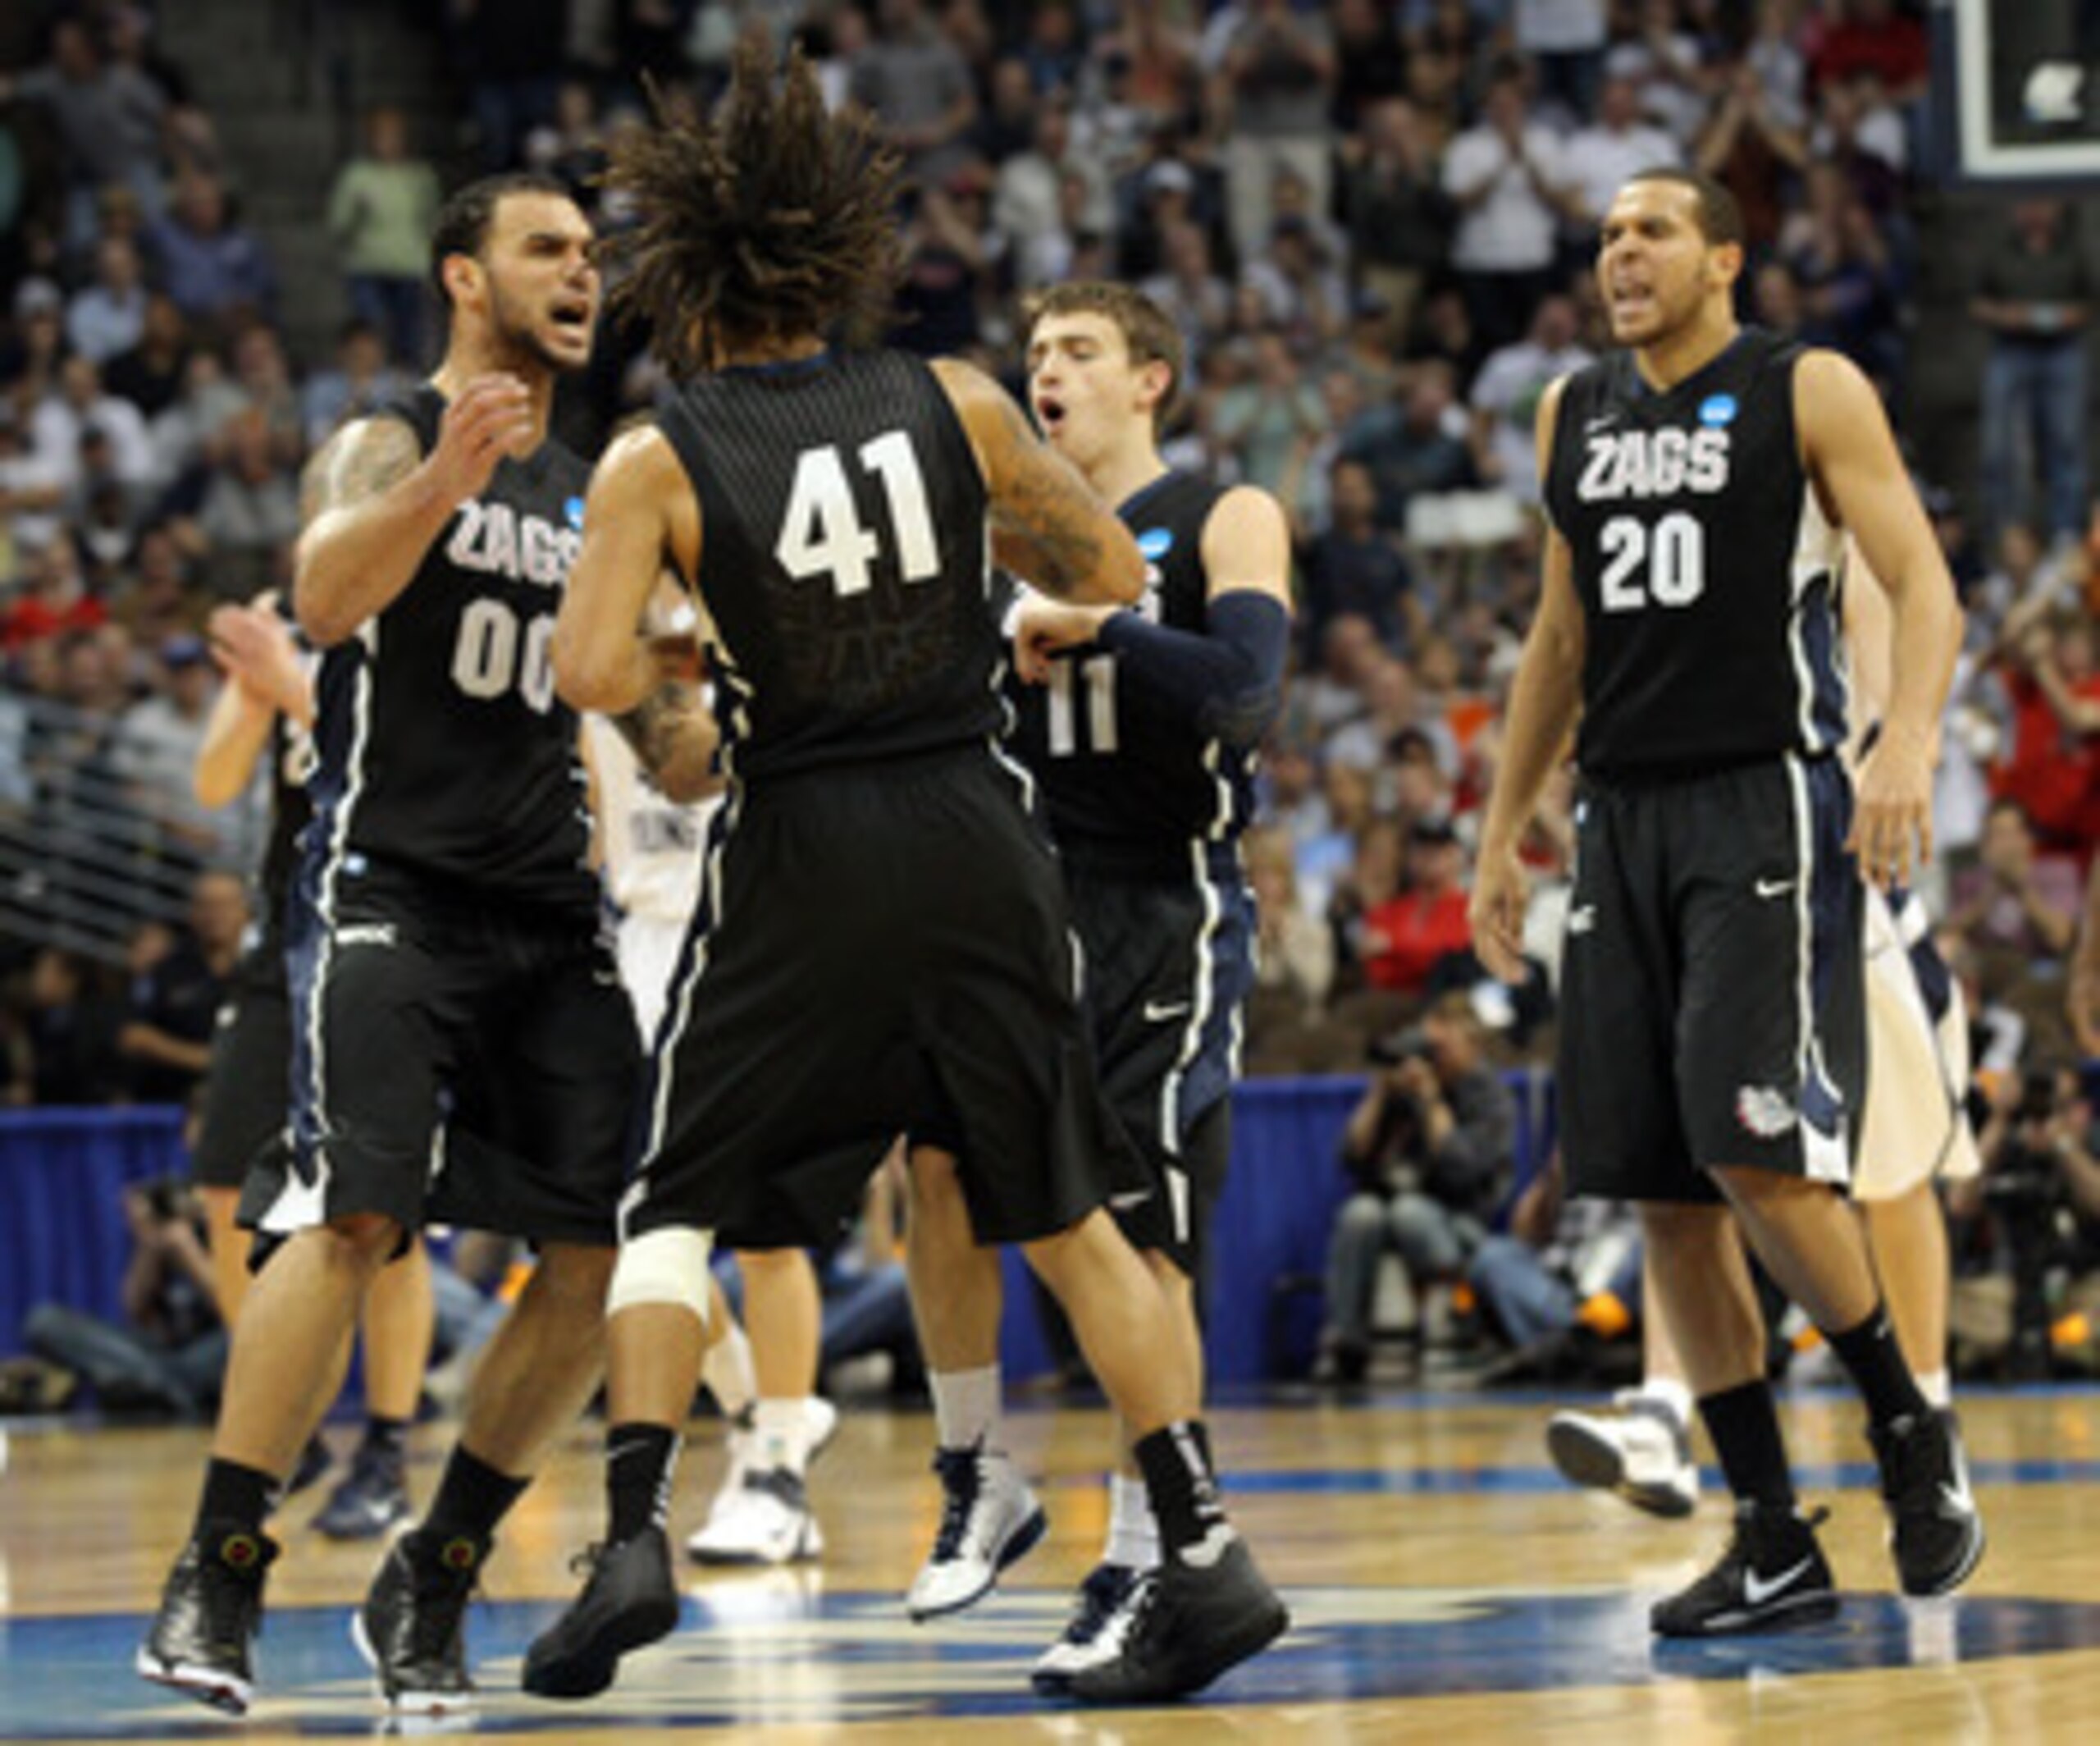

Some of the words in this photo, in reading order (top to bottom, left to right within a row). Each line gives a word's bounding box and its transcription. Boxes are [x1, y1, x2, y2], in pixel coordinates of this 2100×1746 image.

[774, 429, 941, 595] 41
[1577, 426, 1729, 503] ZAGS
[1600, 510, 1704, 611] 20
[1048, 655, 1117, 755] 11
